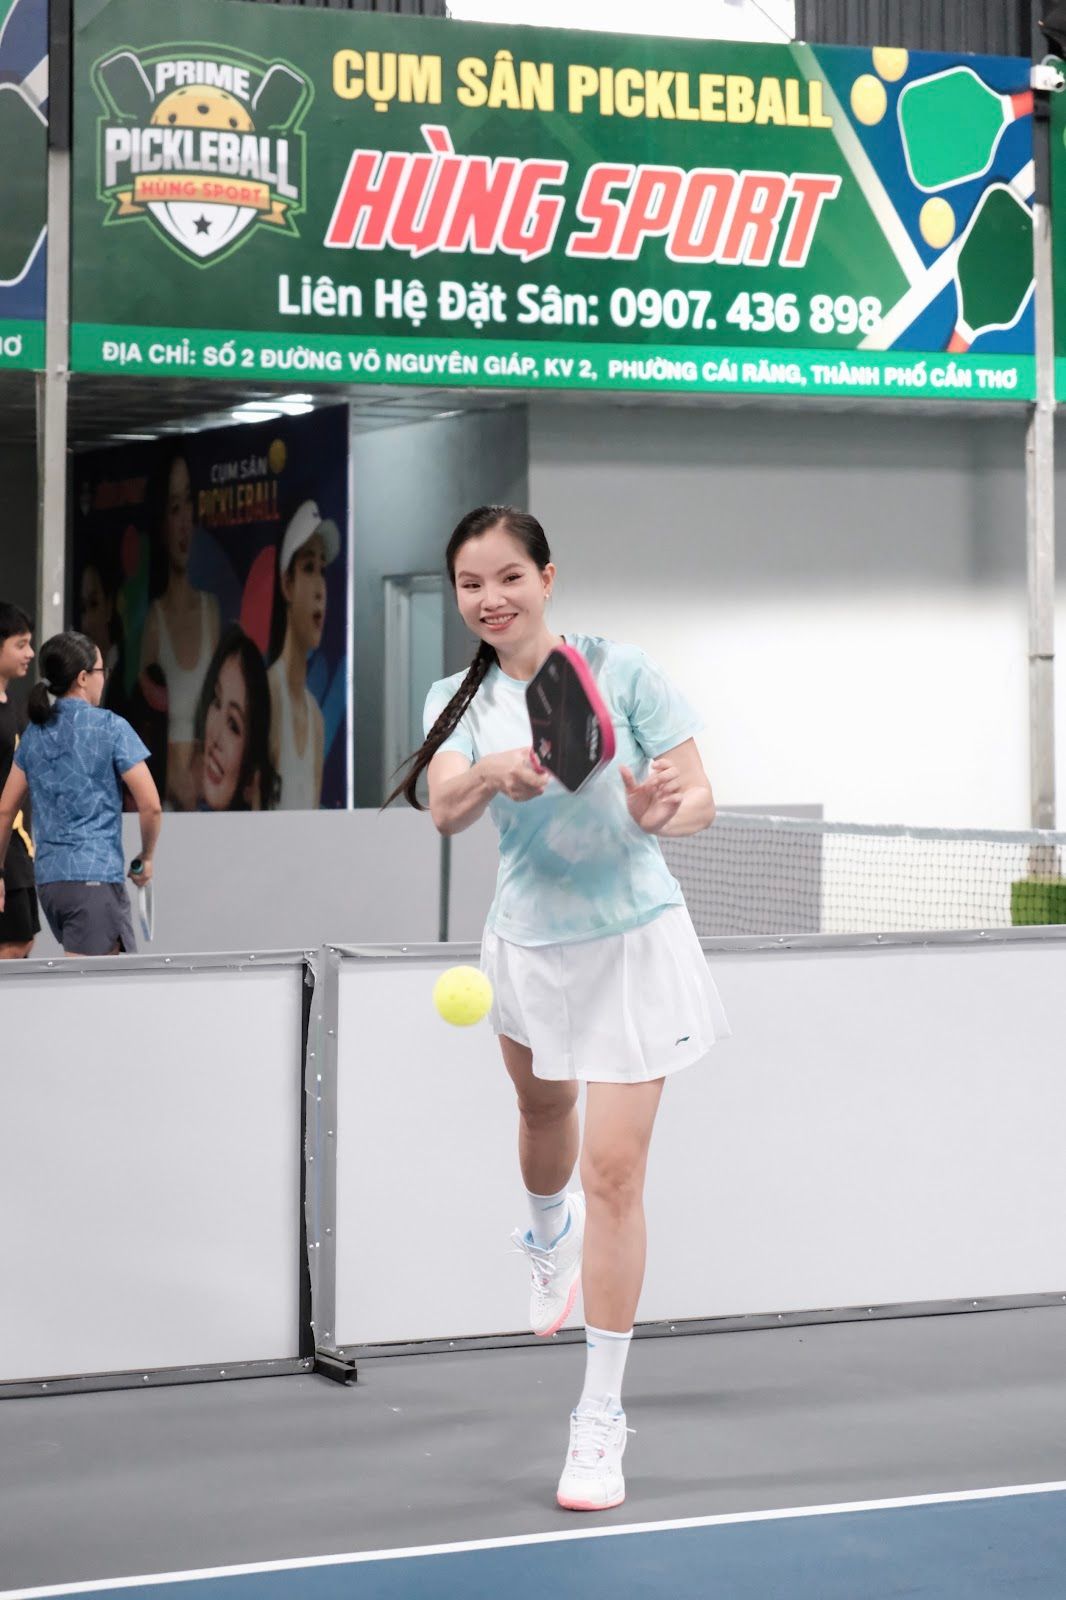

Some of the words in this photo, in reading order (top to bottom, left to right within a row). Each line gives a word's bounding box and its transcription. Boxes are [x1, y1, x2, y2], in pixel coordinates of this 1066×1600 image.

[156, 61, 251, 101] PRIME
[332, 48, 442, 112] CỤM
[457, 50, 554, 111] SÂN
[568, 64, 833, 128] PICKLEBALL
[105, 128, 299, 200] PICKLEBALL
[141, 177, 196, 196] HÙNG
[201, 181, 261, 202] SPORT
[323, 124, 569, 262] HÙNG
[566, 162, 842, 268] SPORT
[278, 274, 362, 317] Liên
[375, 278, 428, 327] Hệ
[438, 281, 506, 329] Đặt
[517, 284, 599, 326] Sân:
[609, 287, 717, 331] 0907.
[726, 292, 800, 333] 436
[809, 295, 883, 337] 898
[102, 341, 143, 366] ĐỊA
[149, 338, 197, 365] CHỈ:
[203, 340, 237, 367] SỐ
[241, 349, 255, 368] 2
[260, 346, 343, 371] ĐƯỜNG
[348, 349, 381, 372] VÕ
[386, 350, 478, 374] NGUYÊN
[484, 352, 540, 379] GIÁP,
[545, 358, 574, 377] KV
[579, 359, 598, 381] 2,
[608, 356, 698, 382] PHƯỜNG
[702, 358, 738, 382] CÁI
[742, 359, 807, 386] RĂNG,
[810, 361, 880, 386] THÀNH
[884, 361, 928, 387] PHỐ
[975, 367, 1018, 389] THƠ
[239, 454, 268, 480] SÂN
